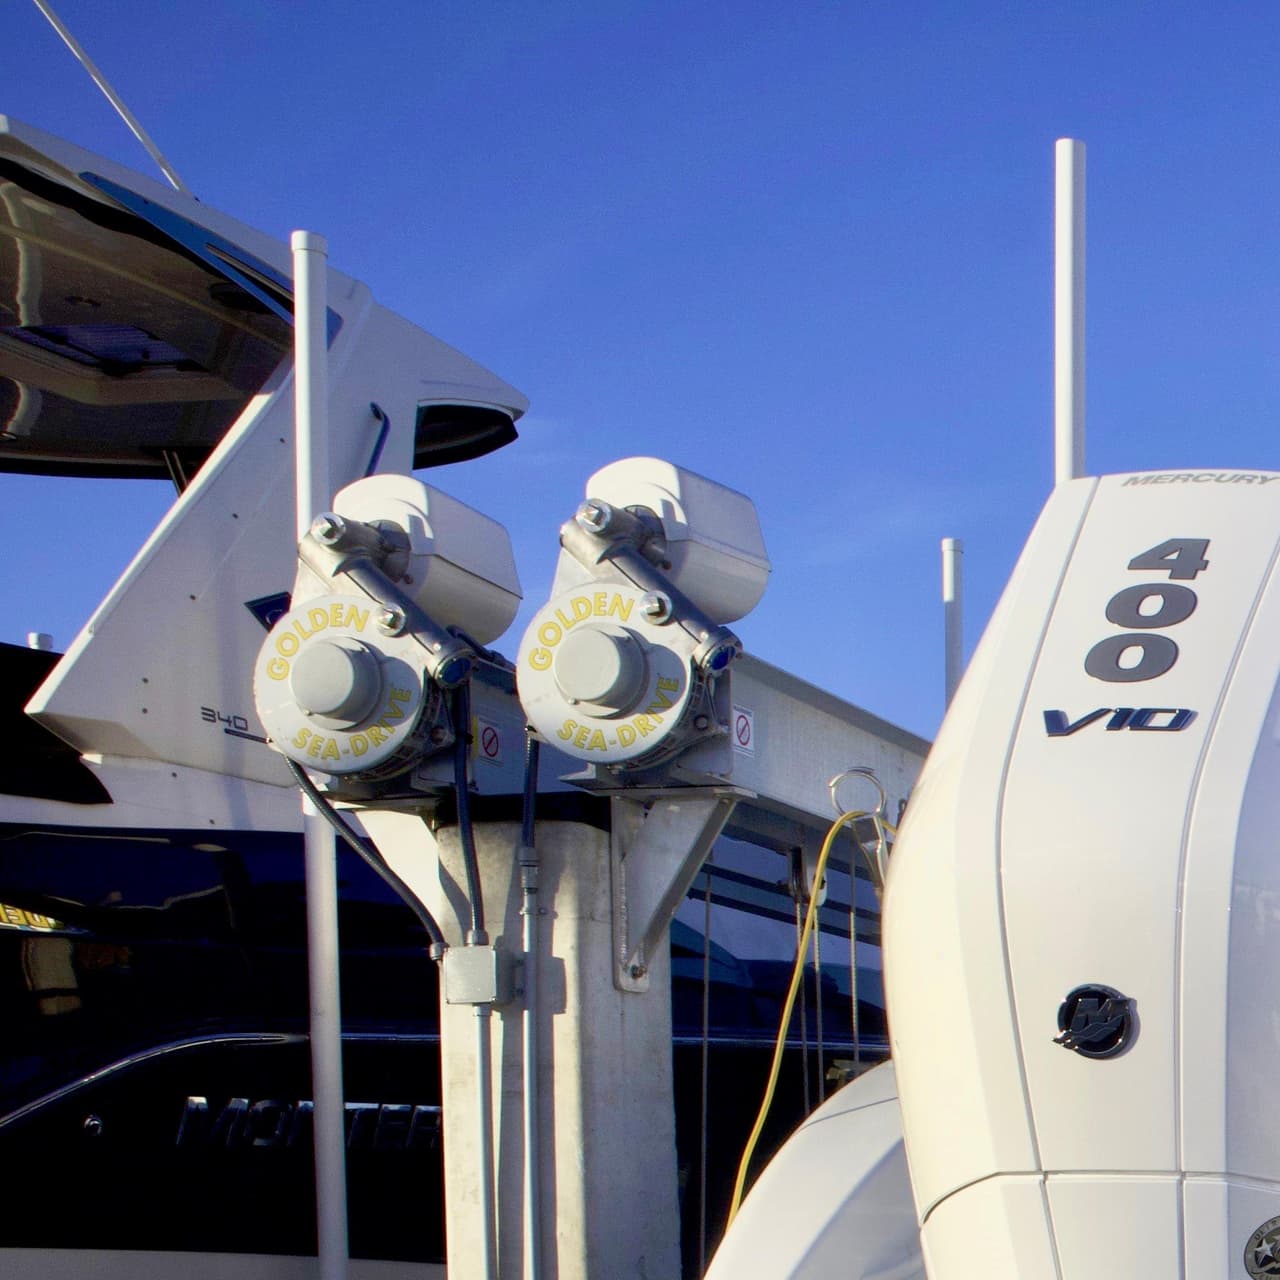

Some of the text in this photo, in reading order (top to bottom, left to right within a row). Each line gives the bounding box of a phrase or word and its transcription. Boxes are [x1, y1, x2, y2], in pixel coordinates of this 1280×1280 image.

[1122, 473, 1280, 487] MERCURY
[266, 603, 369, 681] GOLDEN
[528, 592, 635, 672] GOLDEN
[1084, 538, 1210, 683] 400
[200, 706, 249, 731] 340
[291, 687, 412, 761] SEA-DRIVE
[556, 676, 680, 751] SEA-DRIVE
[1044, 708, 1196, 737] V10
